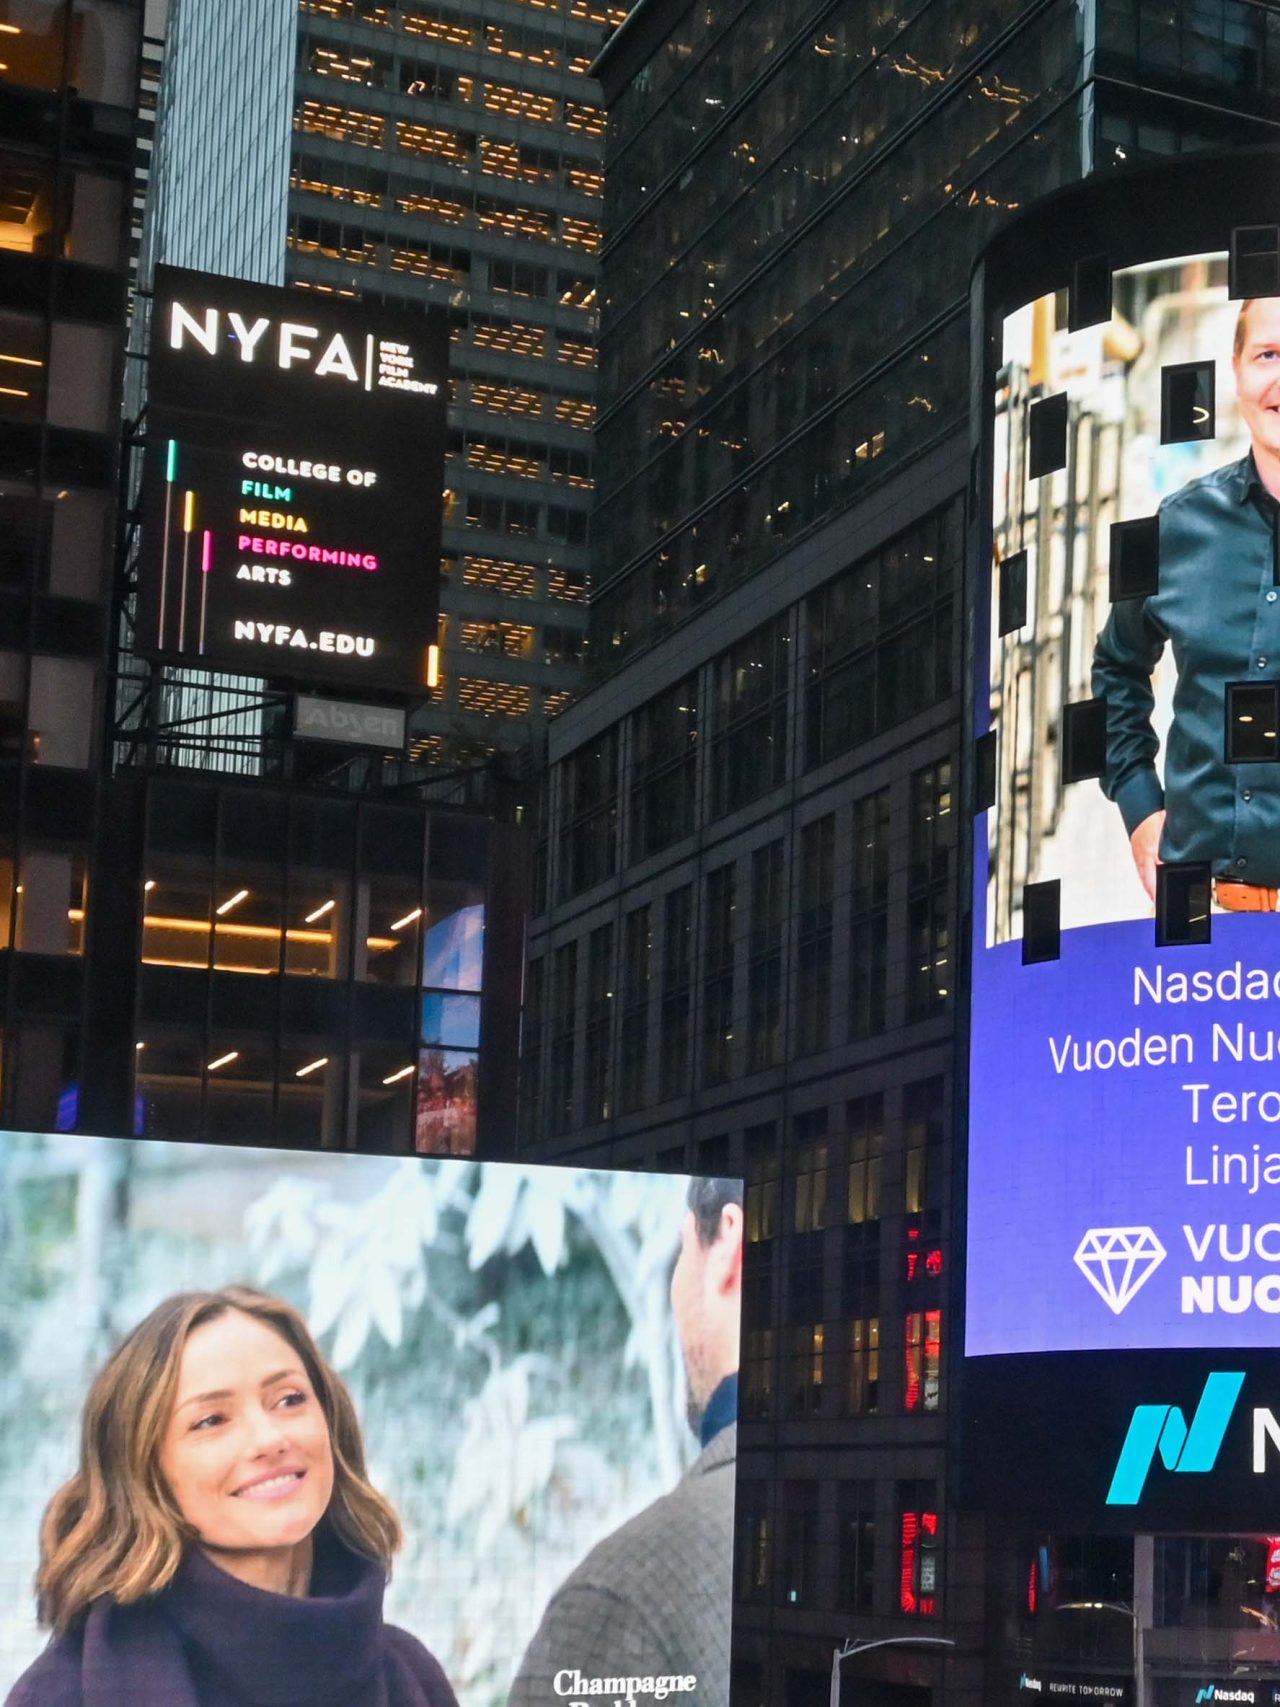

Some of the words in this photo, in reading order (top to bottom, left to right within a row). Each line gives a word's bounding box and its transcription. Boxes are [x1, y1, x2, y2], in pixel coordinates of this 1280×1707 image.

[170, 301, 359, 381] NYFA
[379, 364, 409, 378] FILM
[378, 376, 438, 395] ACADEMY
[242, 452, 342, 482] COLLEGE
[346, 469, 377, 487] OF
[241, 480, 292, 502] FILM
[239, 508, 308, 533] MEDIA
[238, 535, 378, 570] PERFORMING
[236, 564, 292, 586] ARTS
[234, 620, 376, 657] NYFA.EDU
[1049, 1028, 1193, 1074] Vuoden
[553, 1669, 697, 1700] Champagne
[1214, 1689, 1255, 1703] Nasdaq
